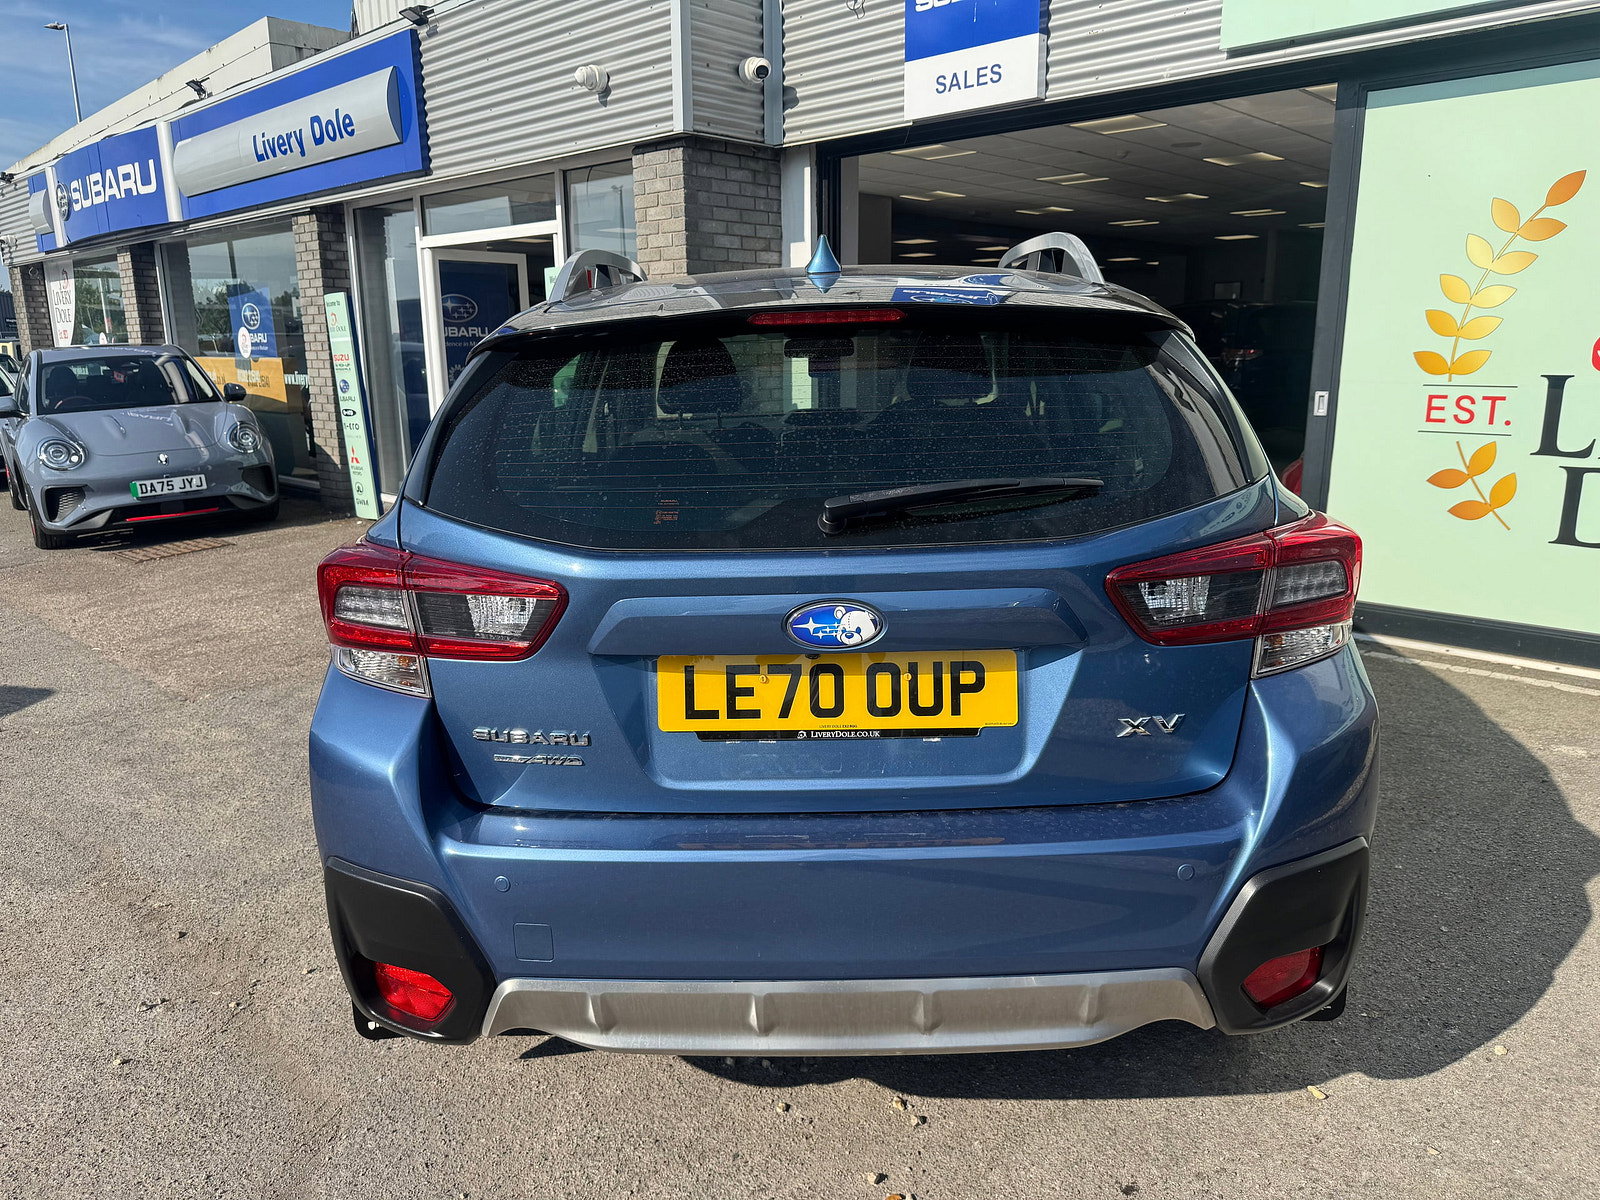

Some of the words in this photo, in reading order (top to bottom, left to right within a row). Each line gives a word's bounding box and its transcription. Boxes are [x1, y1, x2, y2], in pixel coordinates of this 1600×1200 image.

[935, 63, 1002, 94] SALES
[252, 128, 305, 163] Livery
[310, 108, 355, 146] Dole
[70, 159, 157, 212] SUBARU
[249, 332, 268, 344] BARU
[445, 326, 490, 338] BARU
[1425, 394, 1512, 426] EST.
[1529, 374, 1600, 460] L
[139, 480, 175, 495] DA75
[179, 476, 204, 490] JYJ
[685, 664, 845, 719] LE70
[866, 661, 986, 717] OUP
[472, 726, 591, 746] SUBARU
[1117, 713, 1186, 738] XV
